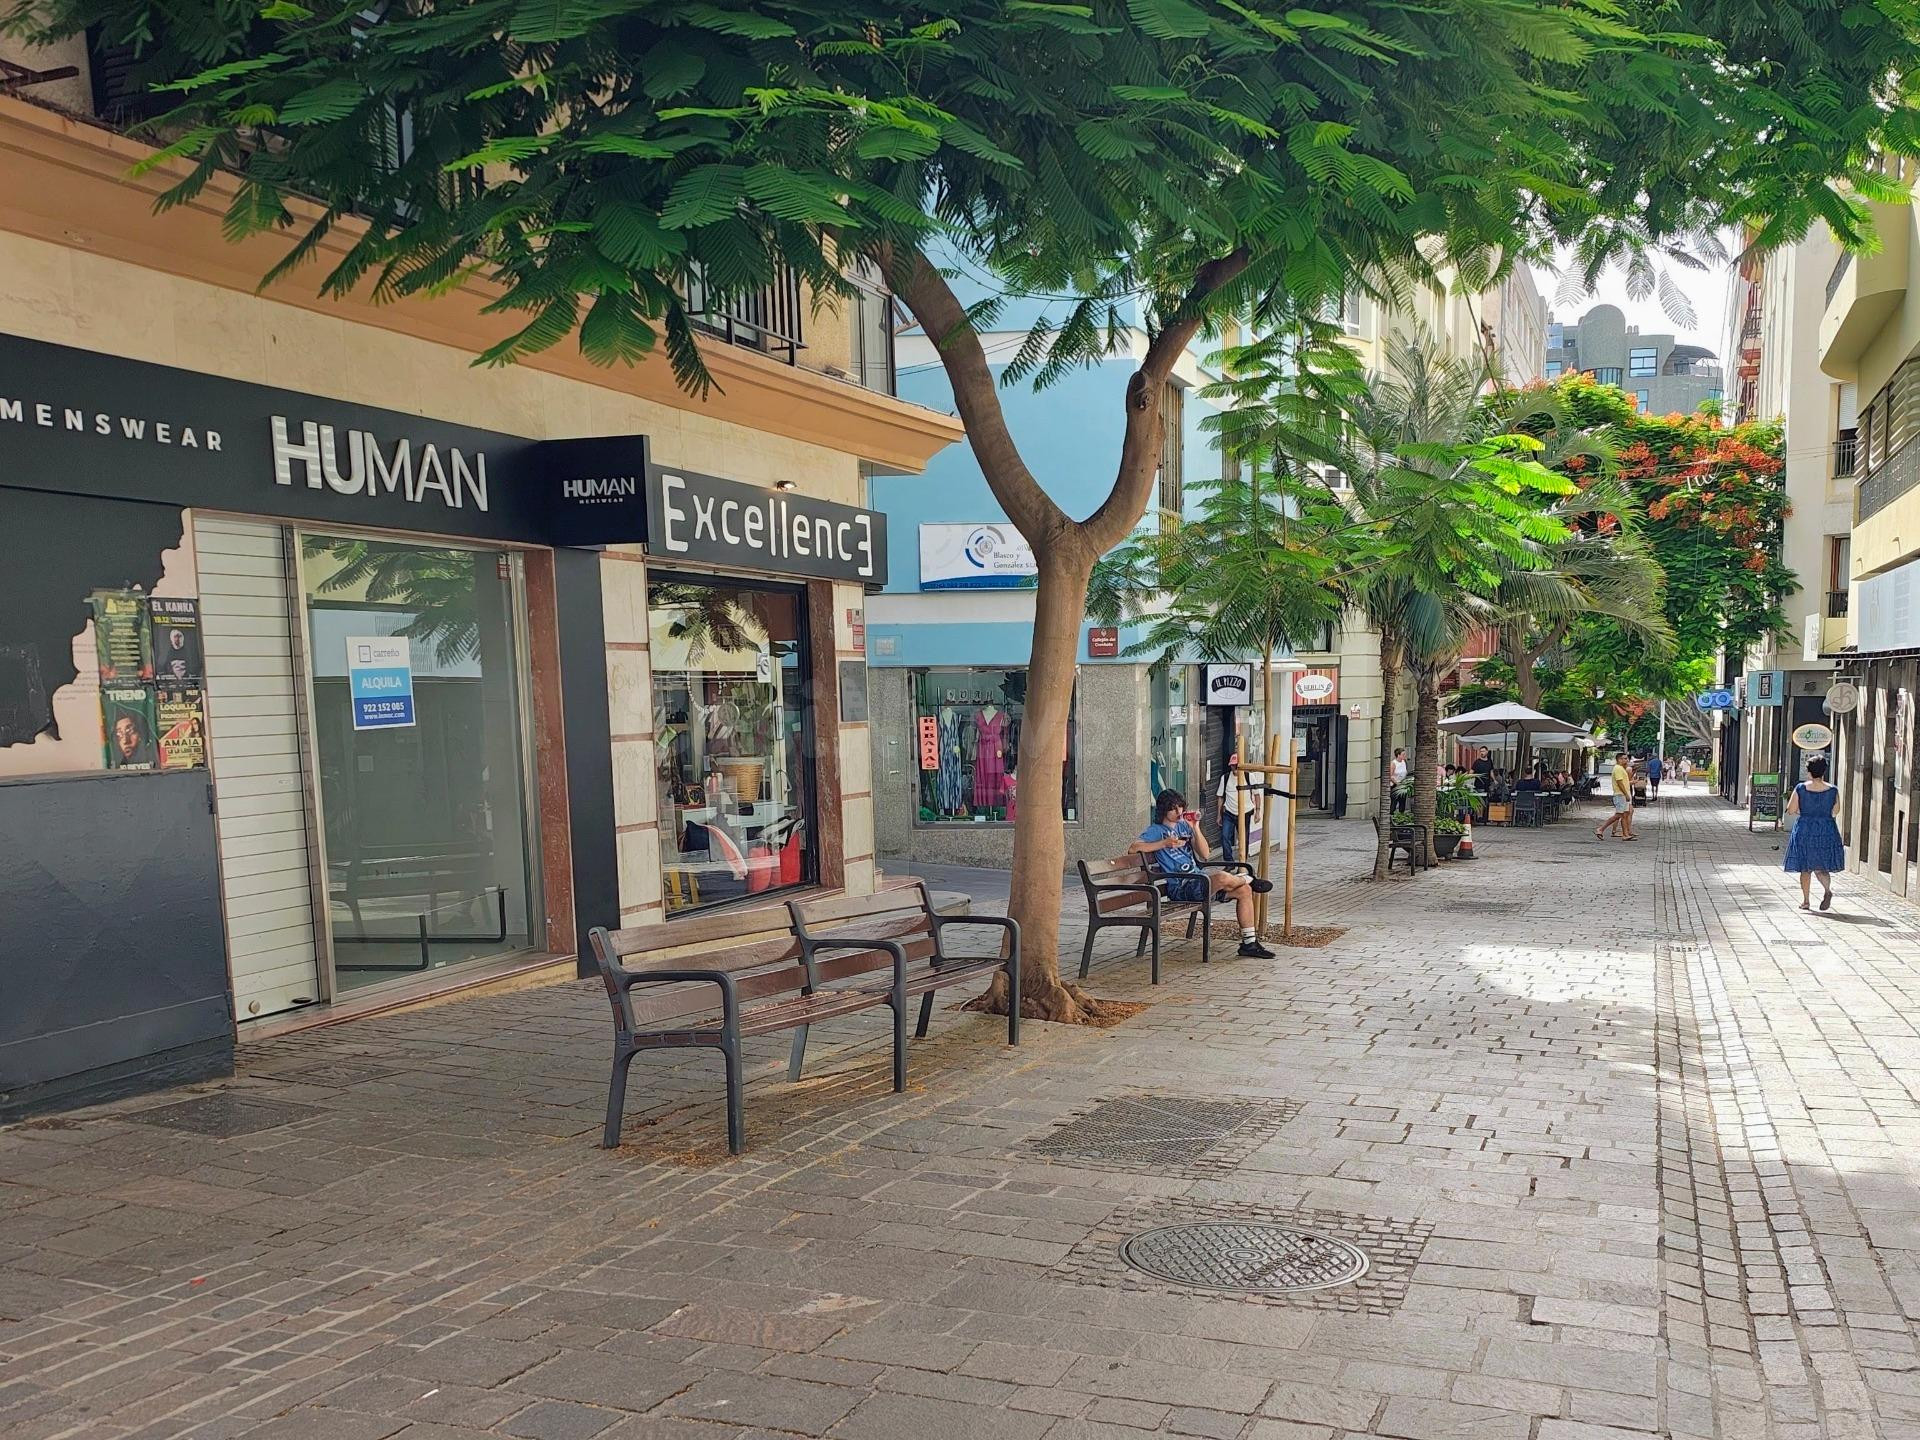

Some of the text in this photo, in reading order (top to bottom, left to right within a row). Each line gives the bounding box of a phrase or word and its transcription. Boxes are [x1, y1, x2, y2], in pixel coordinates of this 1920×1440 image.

[0, 397, 222, 451] MENSWEAR
[270, 415, 489, 512] HUMAN
[563, 477, 635, 498] HUMAN
[152, 601, 163, 611] EL
[165, 601, 195, 613] KANKA
[361, 677, 402, 690] ALQUILA
[108, 689, 147, 701] TREND
[160, 703, 197, 711] LOQUILLO
[363, 703, 377, 712] 922
[378, 702, 391, 711] 152
[164, 738, 199, 746] AMAIA
[923, 718, 936, 769] REBAJAS
